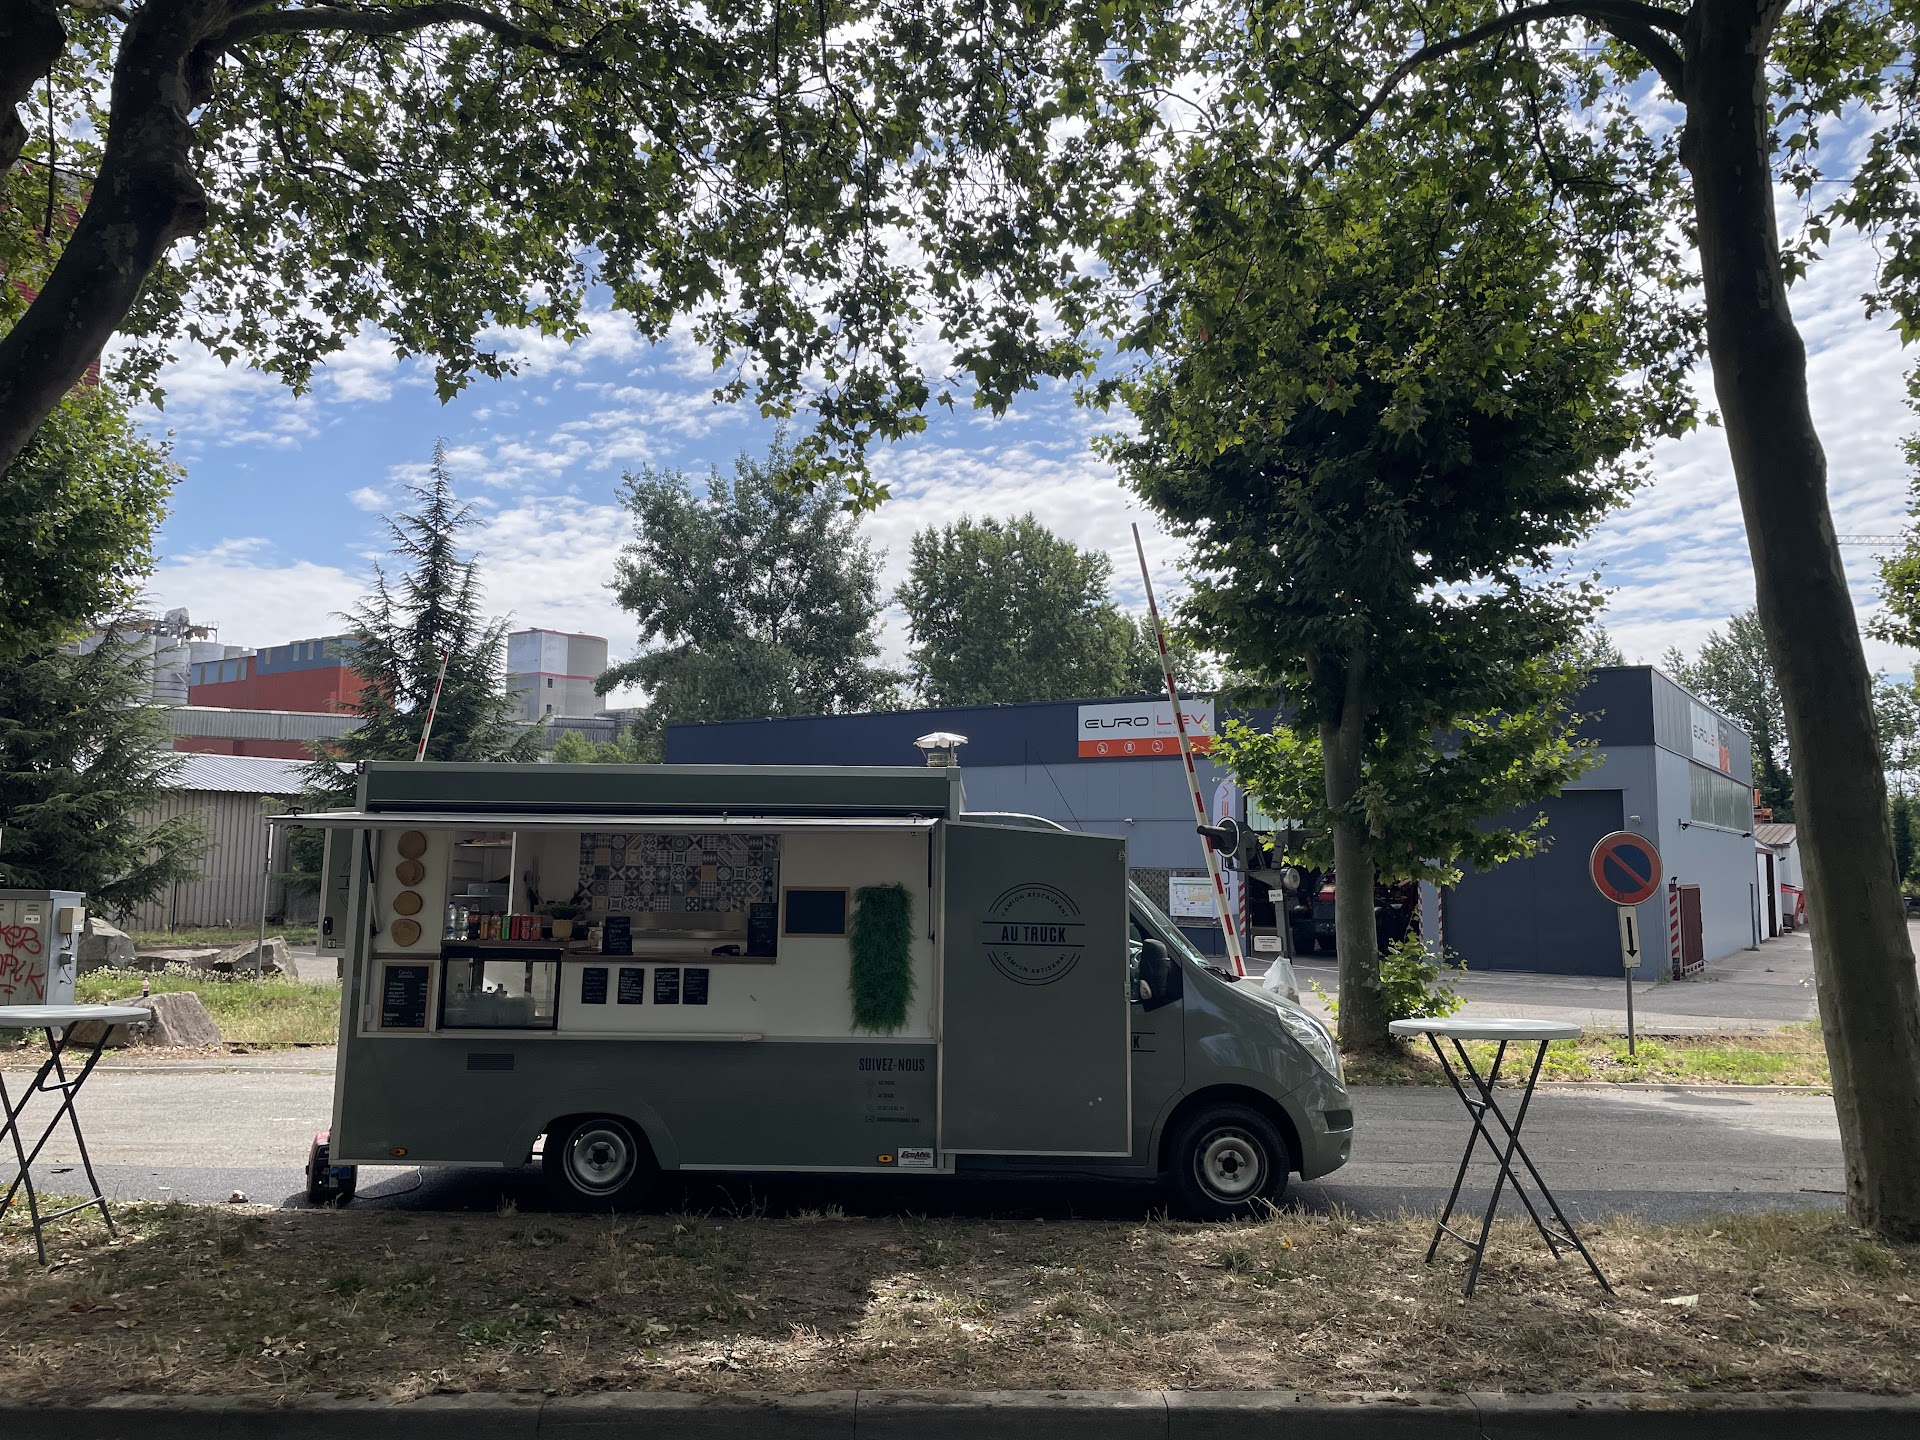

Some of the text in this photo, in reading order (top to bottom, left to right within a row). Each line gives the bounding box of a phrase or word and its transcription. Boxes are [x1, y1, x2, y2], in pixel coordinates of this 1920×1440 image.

[1084, 716, 1149, 729] EURO
[1001, 892, 1069, 918] CAMION RESTAURANT
[1001, 925, 1066, 943] AU TRUCK
[1003, 951, 1028, 972] CAMION
[858, 1057, 925, 1072] SUIVEZ-NOUS
